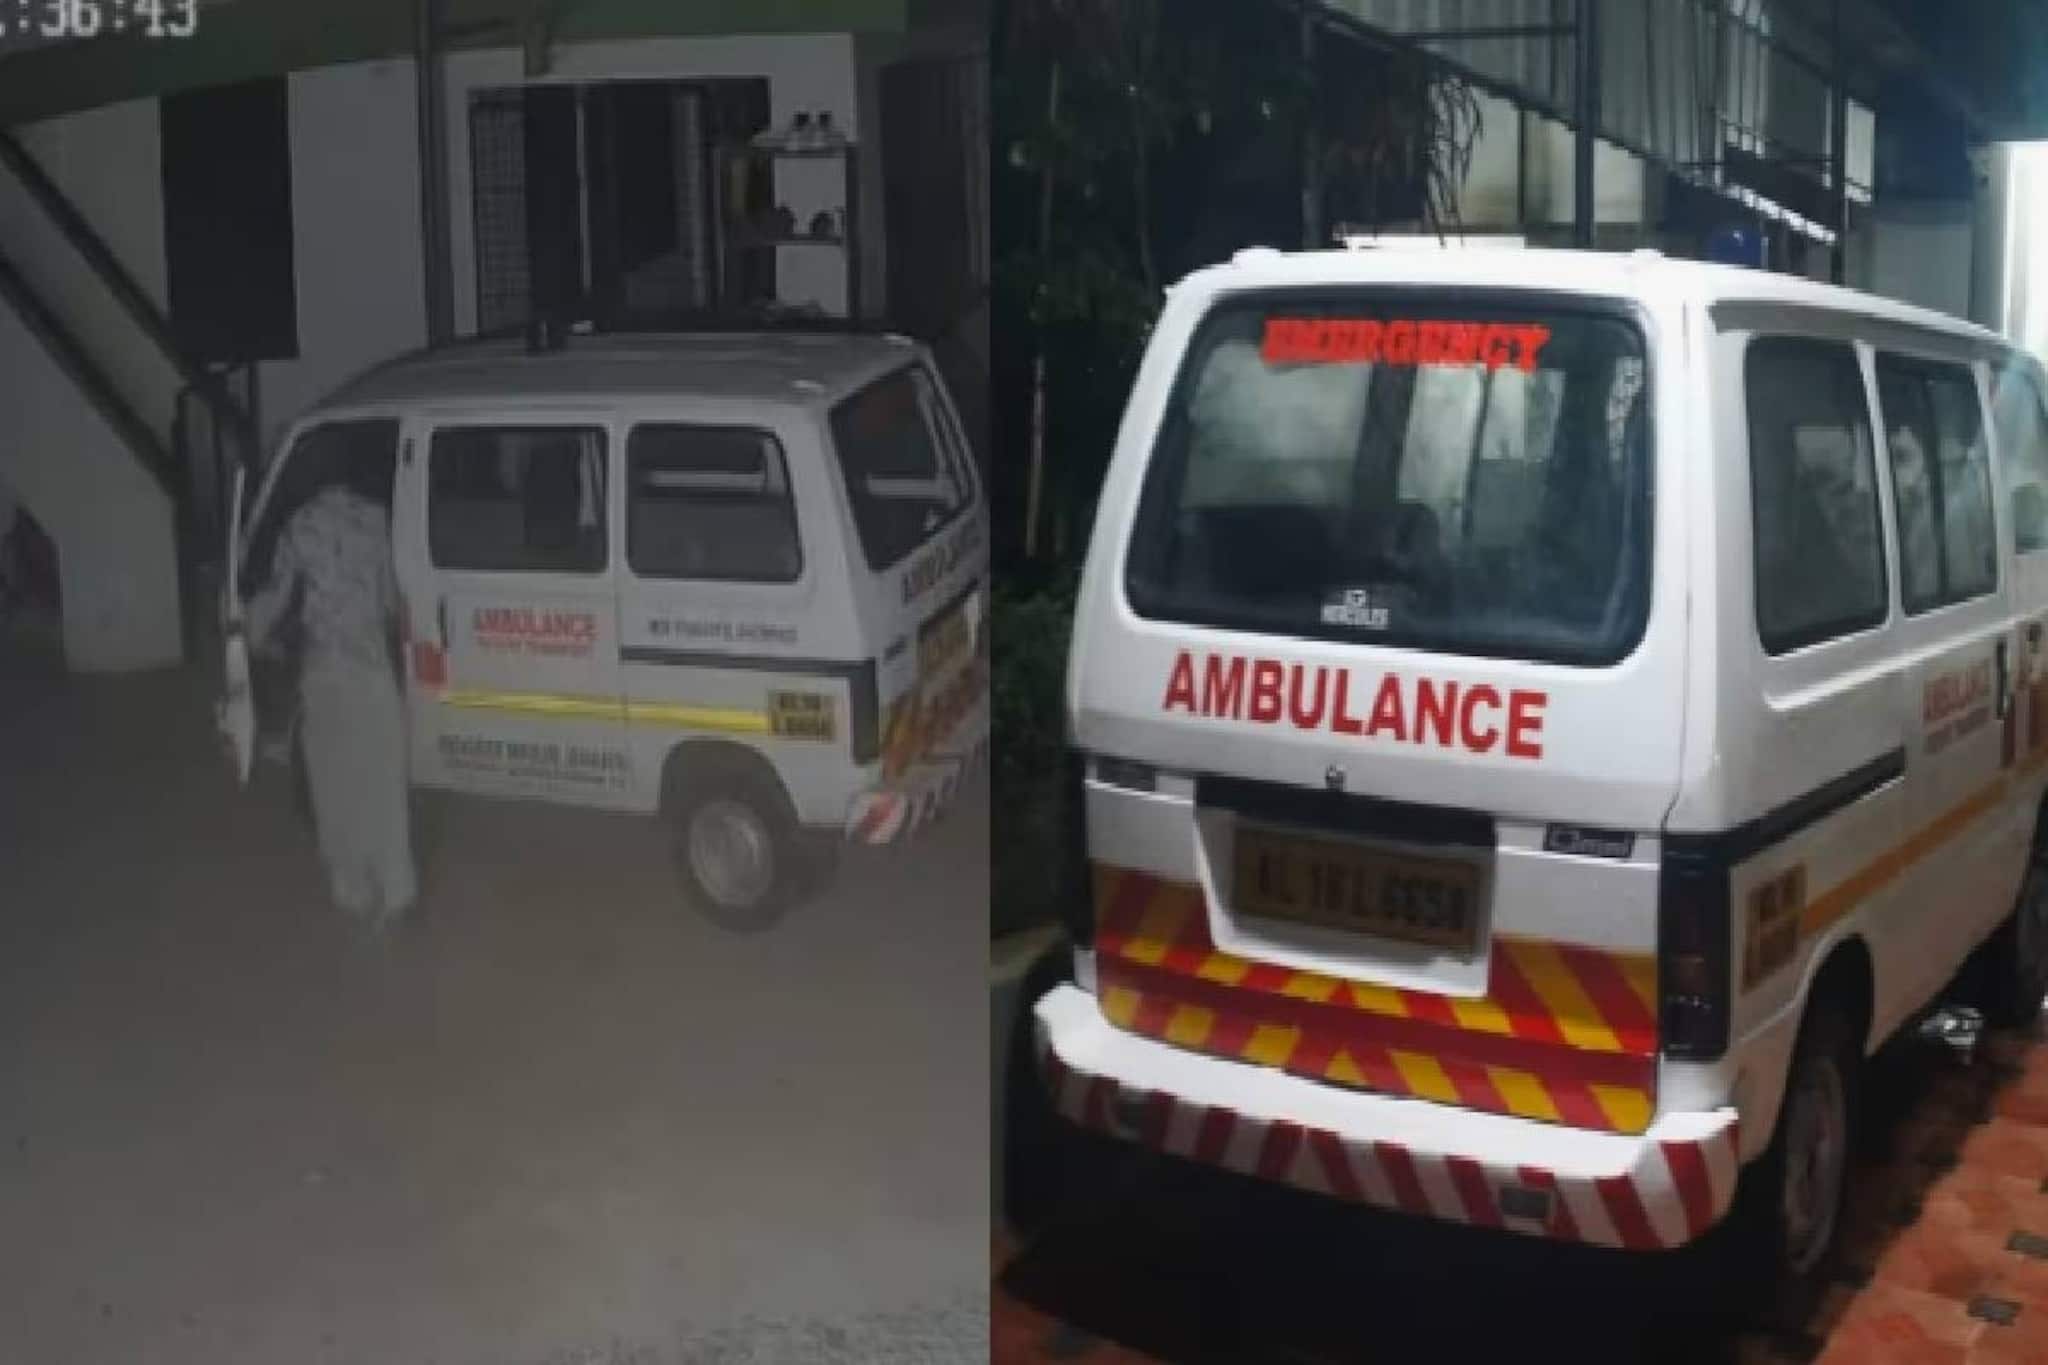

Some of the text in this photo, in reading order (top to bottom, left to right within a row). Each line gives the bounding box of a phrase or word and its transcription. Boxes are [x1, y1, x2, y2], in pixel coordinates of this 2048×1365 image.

[1260, 317, 1550, 374] EMERGENCY
[473, 607, 598, 640] AMBULANCE
[1161, 650, 1549, 760] AMBULANCE
